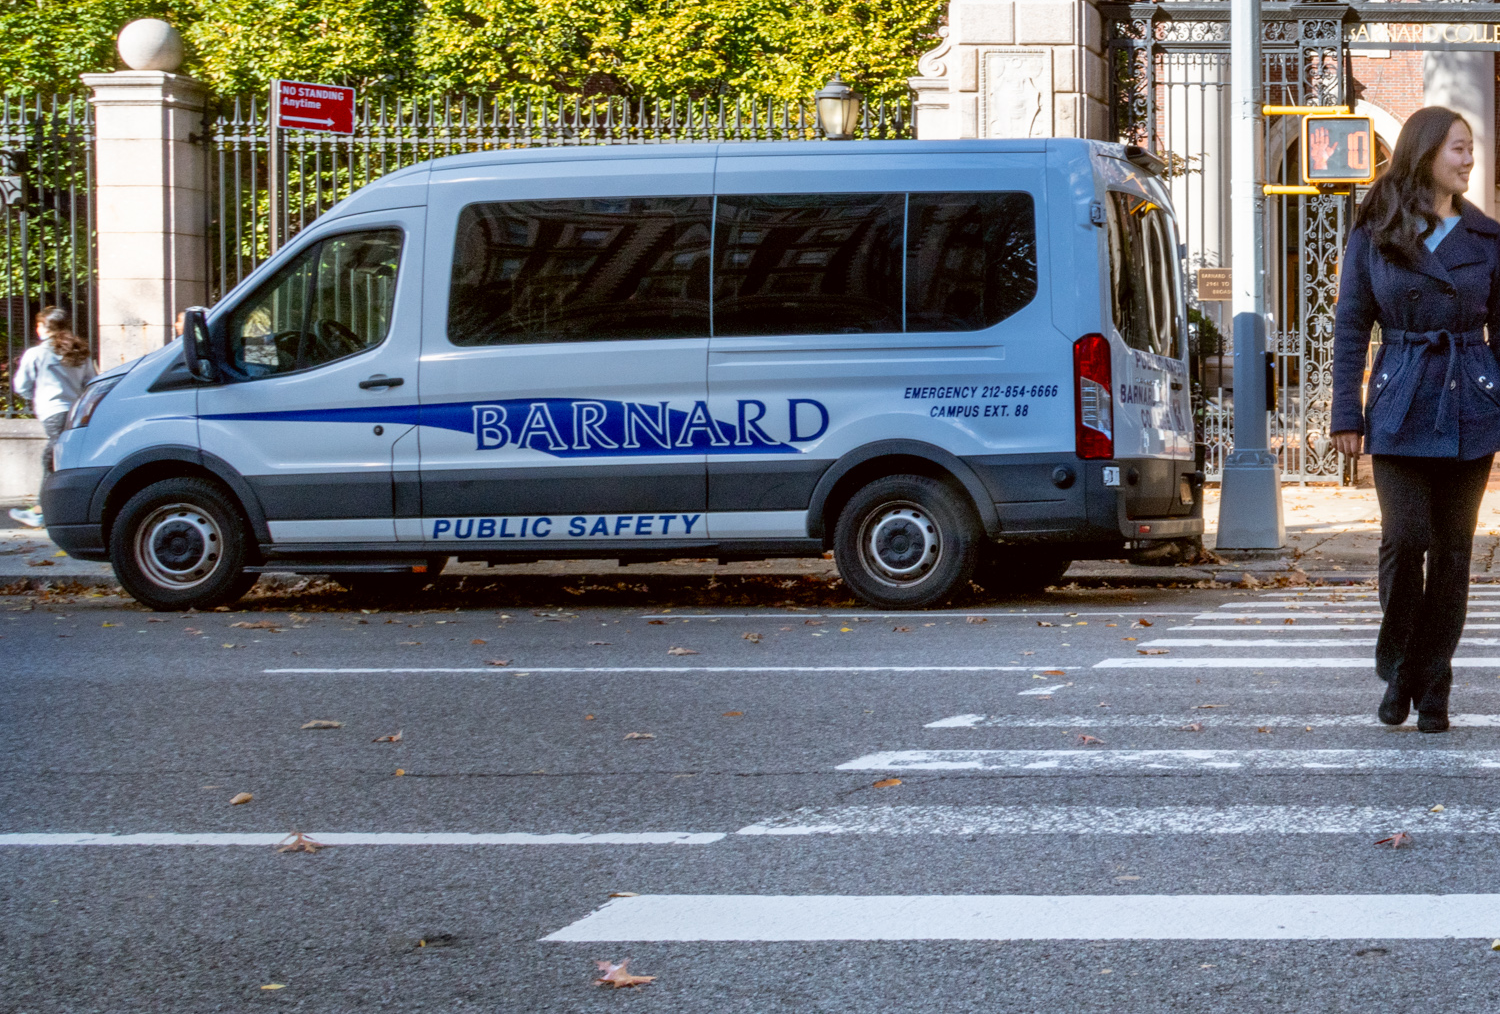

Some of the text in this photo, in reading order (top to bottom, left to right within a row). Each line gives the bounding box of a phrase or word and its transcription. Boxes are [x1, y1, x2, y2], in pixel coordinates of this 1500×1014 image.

[282, 85, 344, 101] NO STANDING
[282, 96, 322, 109] Anytime
[903, 384, 1059, 399] EMERGENCY 212-854-6666
[930, 404, 1029, 418] CAMPUS EXT. 88
[471, 397, 831, 451] BARNARD
[432, 514, 702, 540] PUBLIC SAFETY
